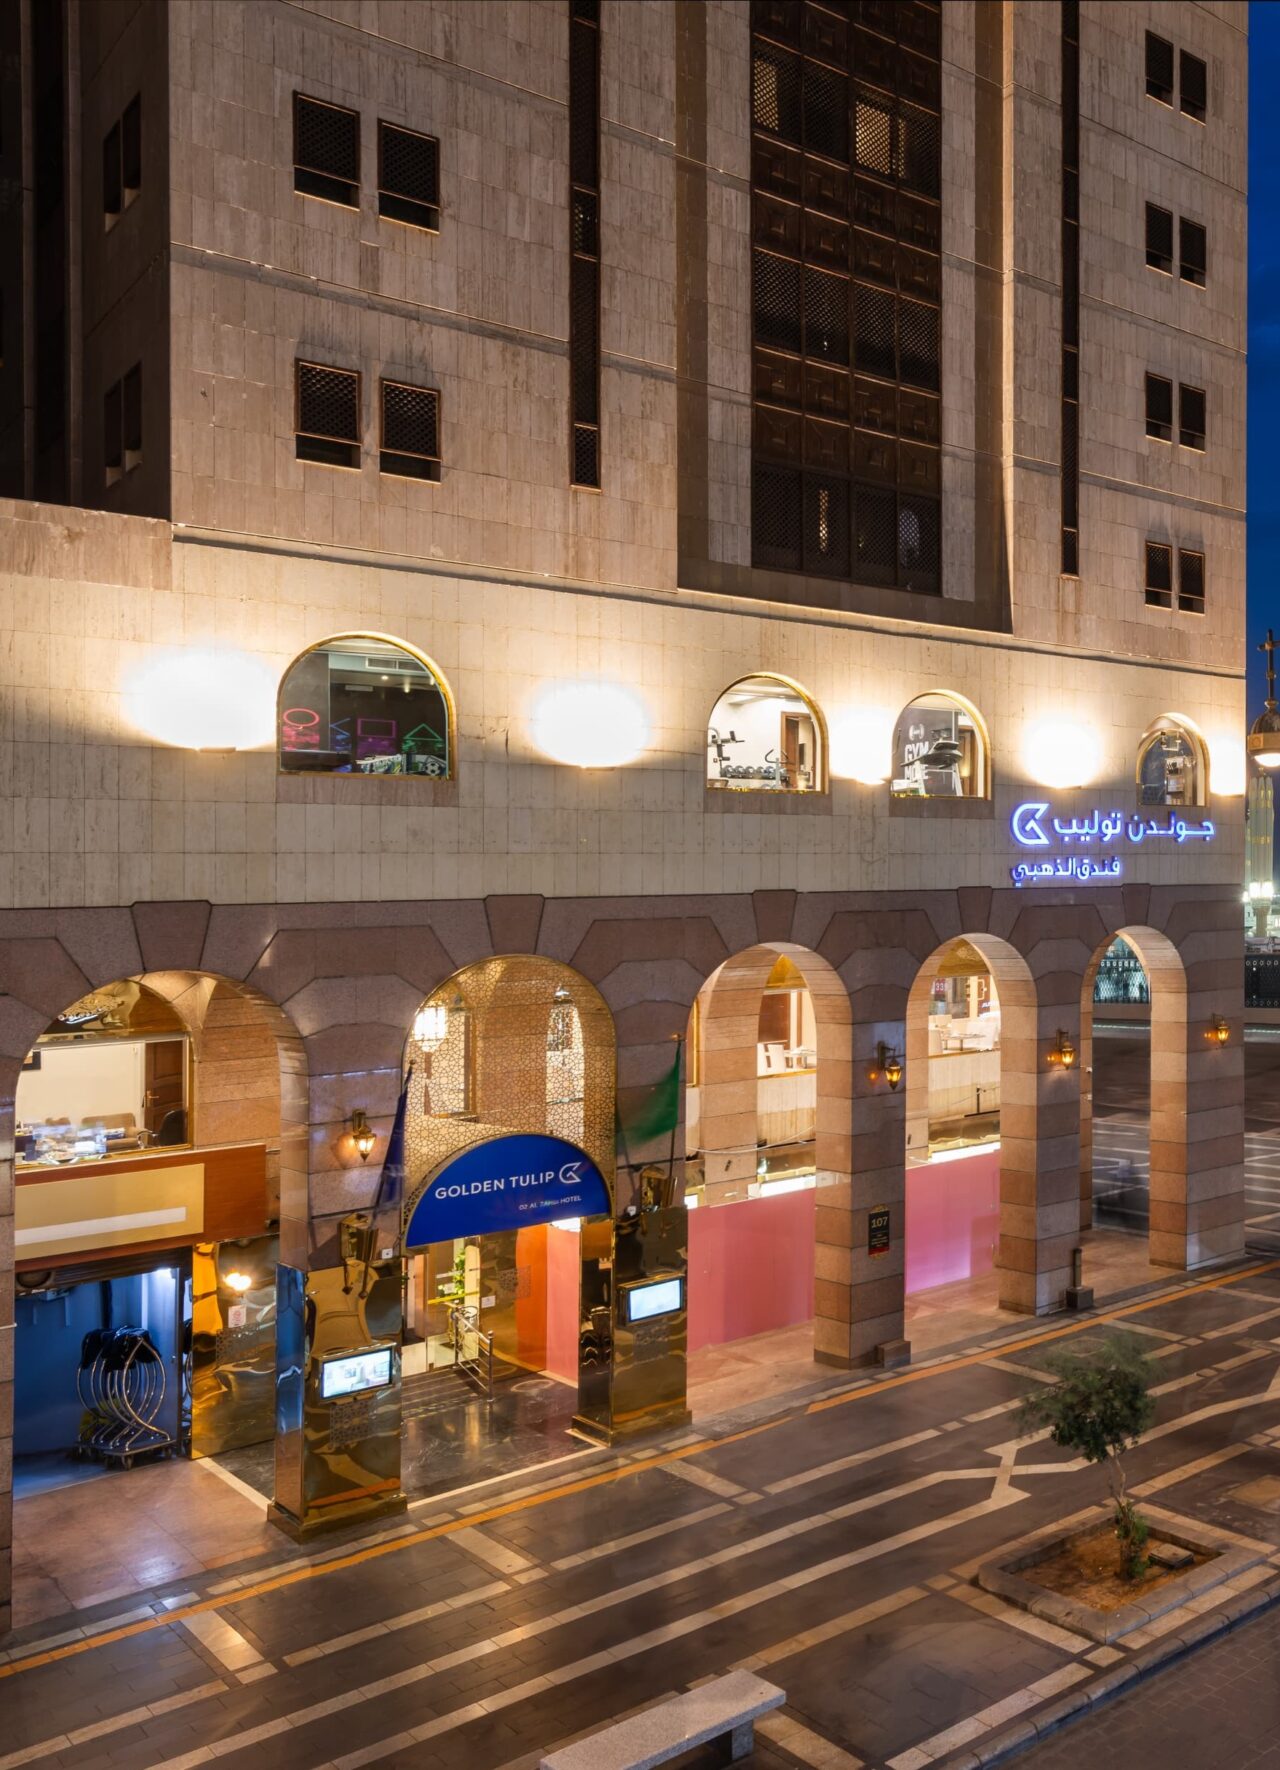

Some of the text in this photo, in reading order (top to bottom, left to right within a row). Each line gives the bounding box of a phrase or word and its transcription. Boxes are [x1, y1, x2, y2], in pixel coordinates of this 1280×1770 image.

[904, 741, 929, 762] GYM
[1053, 810, 1215, 842] جولدن توليب
[1012, 856, 1120, 887] فندق الذهبي
[435, 1171, 555, 1199] GOLDEN TULIP
[560, 1194, 582, 1204] HOTEL
[871, 1216, 888, 1229] 107
